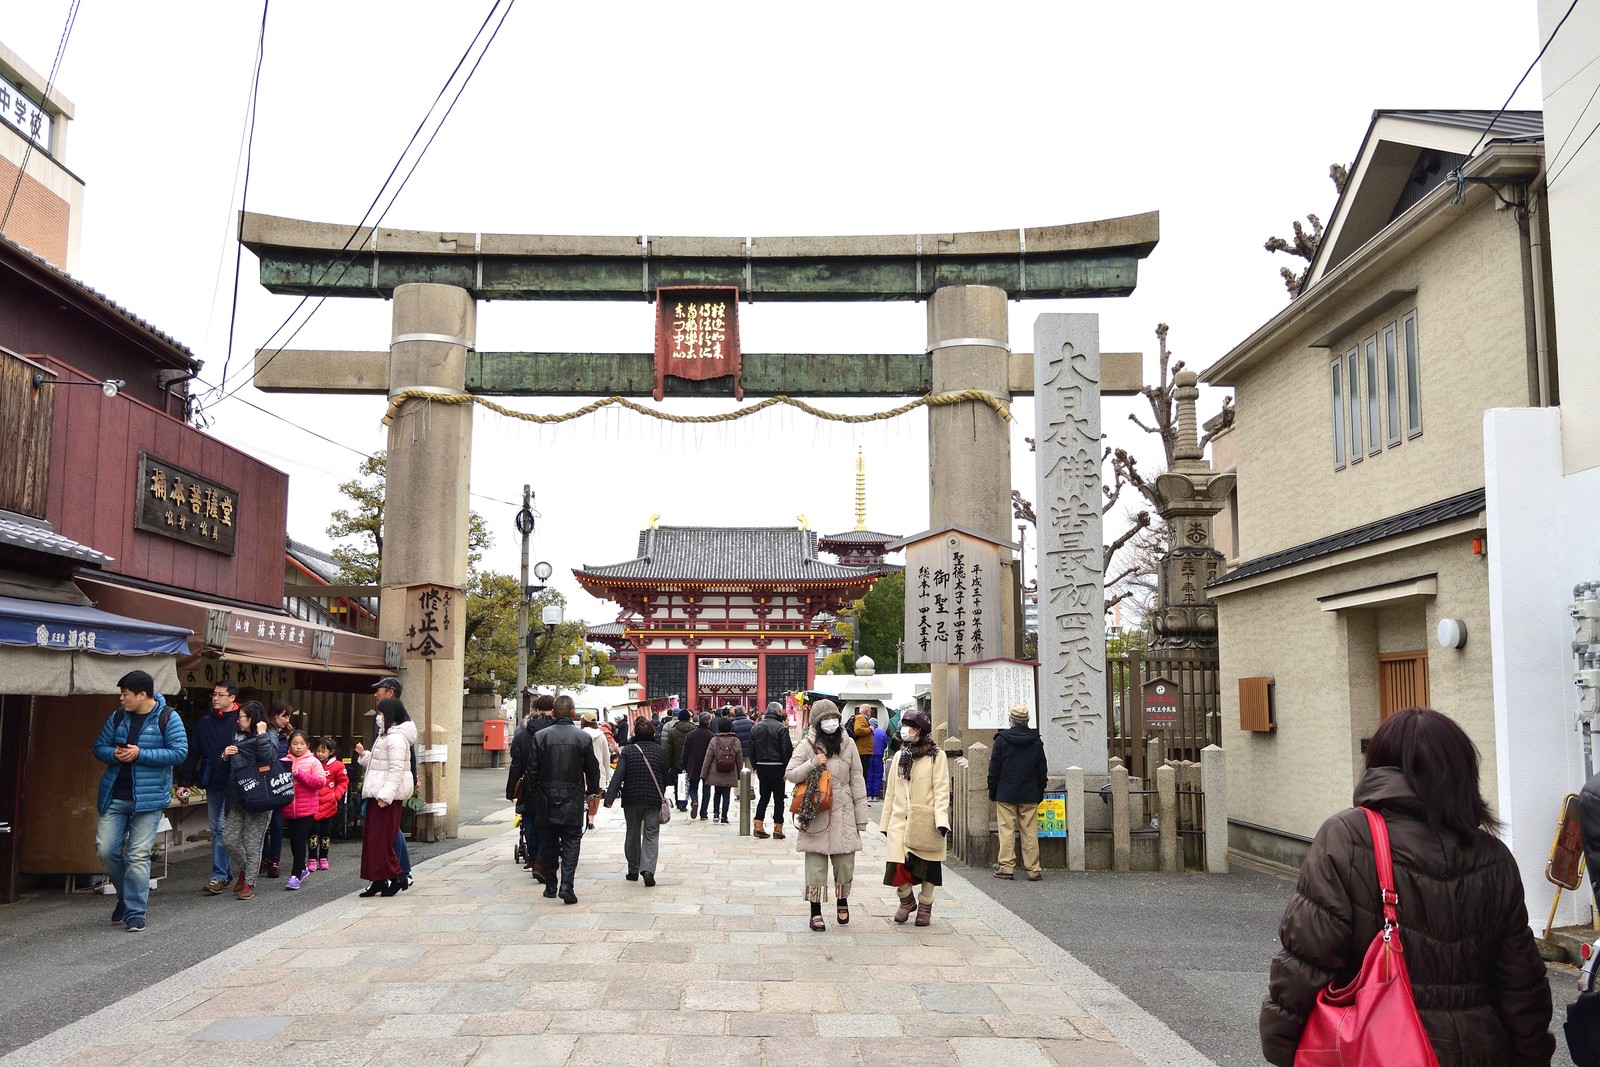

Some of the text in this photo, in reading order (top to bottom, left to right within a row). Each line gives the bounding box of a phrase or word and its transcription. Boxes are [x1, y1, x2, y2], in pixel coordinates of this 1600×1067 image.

[0, 86, 42, 140] 中学校
[150, 467, 233, 528] 楠本菩薩堂
[1043, 341, 1102, 742] 大日本佛法最初四天王寺
[918, 606, 932, 653] 四天王寺
